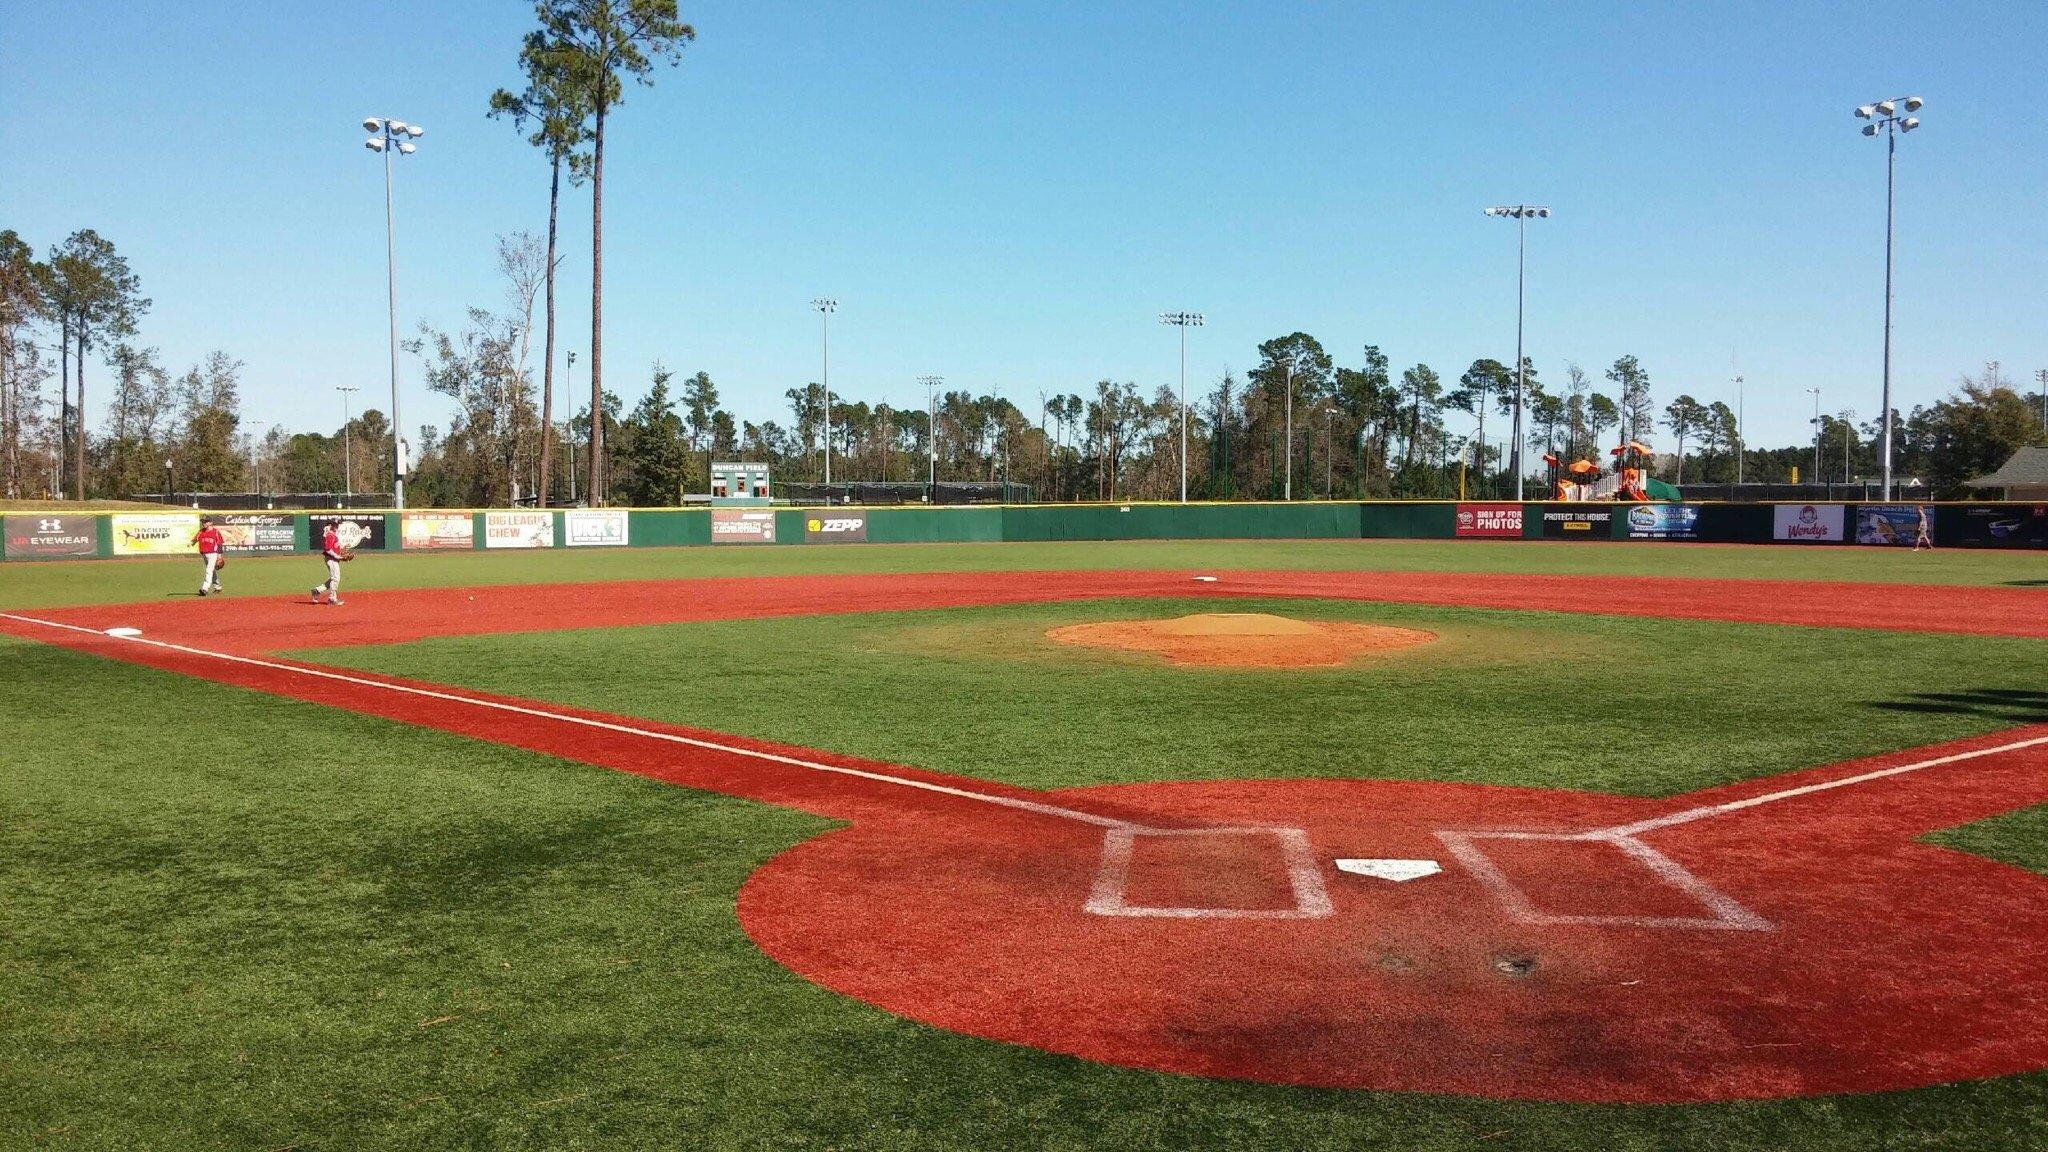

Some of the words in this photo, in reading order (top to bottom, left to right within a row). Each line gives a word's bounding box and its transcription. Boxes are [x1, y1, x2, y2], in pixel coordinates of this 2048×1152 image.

[488, 516, 506, 526] BIG
[508, 515, 546, 526] LEAGUE
[1544, 513, 1574, 521] PROTECT
[1574, 513, 1586, 521] THIS
[1587, 513, 1610, 521] HOUSE
[822, 518, 862, 532] ZEPP
[1477, 518, 1522, 530] PHOTOS
[489, 528, 520, 538] CHEW
[1788, 524, 1828, 538] Wendy's
[30, 536, 89, 544] EYEWEAR
